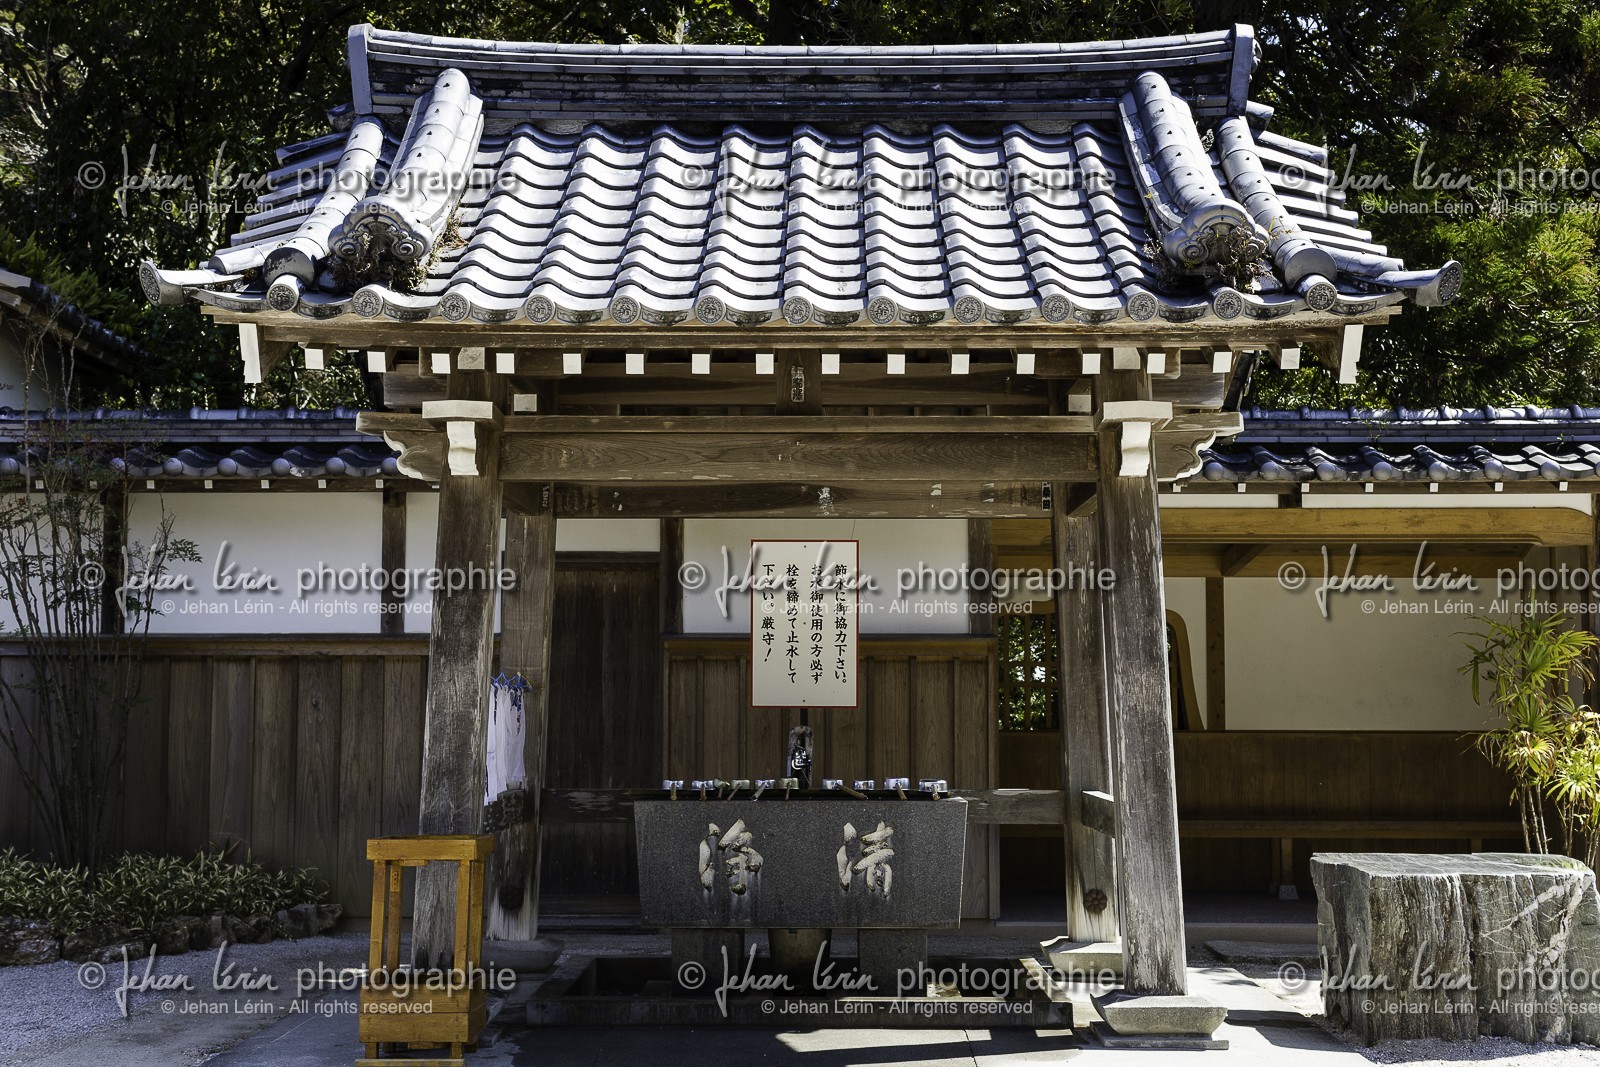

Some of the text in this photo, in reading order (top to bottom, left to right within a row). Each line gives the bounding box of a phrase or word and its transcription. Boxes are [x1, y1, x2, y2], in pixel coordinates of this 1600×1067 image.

[785, 563, 800, 684] 栓を締めて止水して
